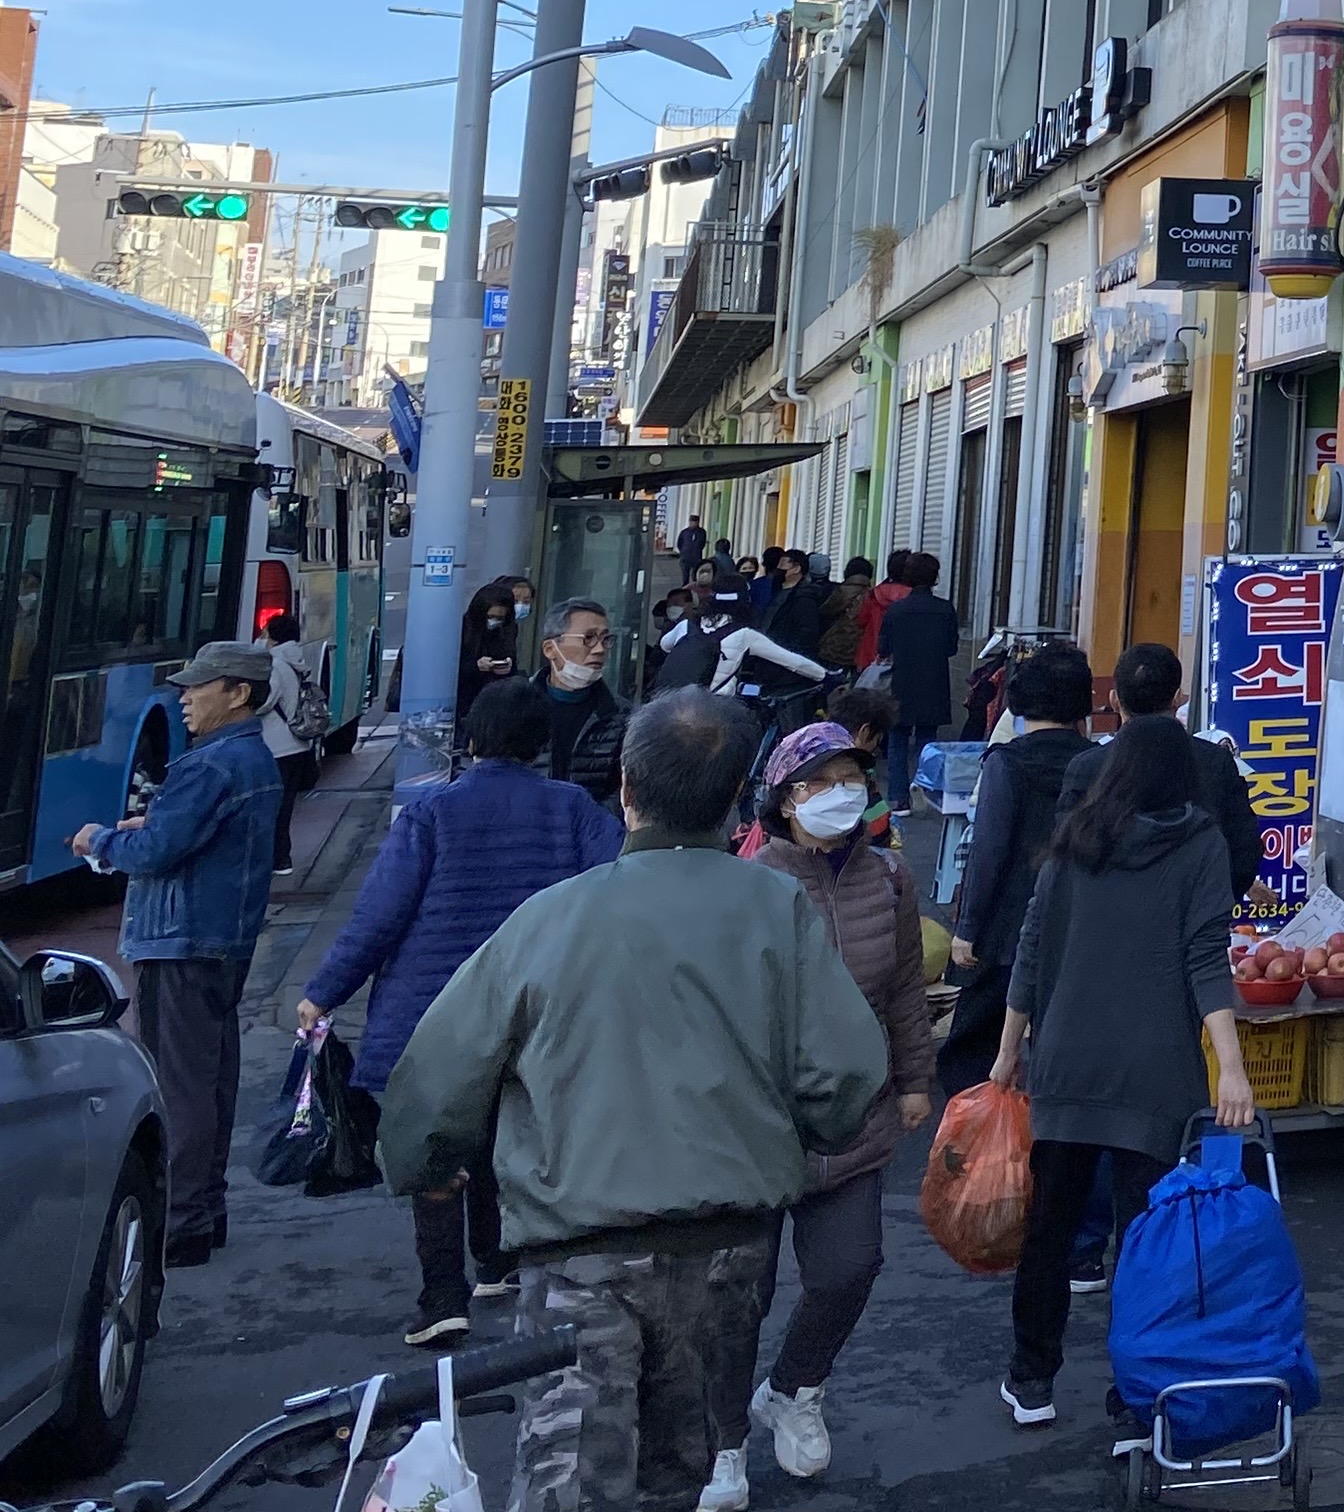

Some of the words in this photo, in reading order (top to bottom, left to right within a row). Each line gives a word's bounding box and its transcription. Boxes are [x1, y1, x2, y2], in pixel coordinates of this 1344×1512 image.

[1276, 51, 1316, 225] 미용실
[1168, 226, 1253, 241] COMMUNITY
[1273, 229, 1317, 252] Hair
[1232, 570, 1327, 707] 열쇠
[1240, 717, 1318, 818] 도장
